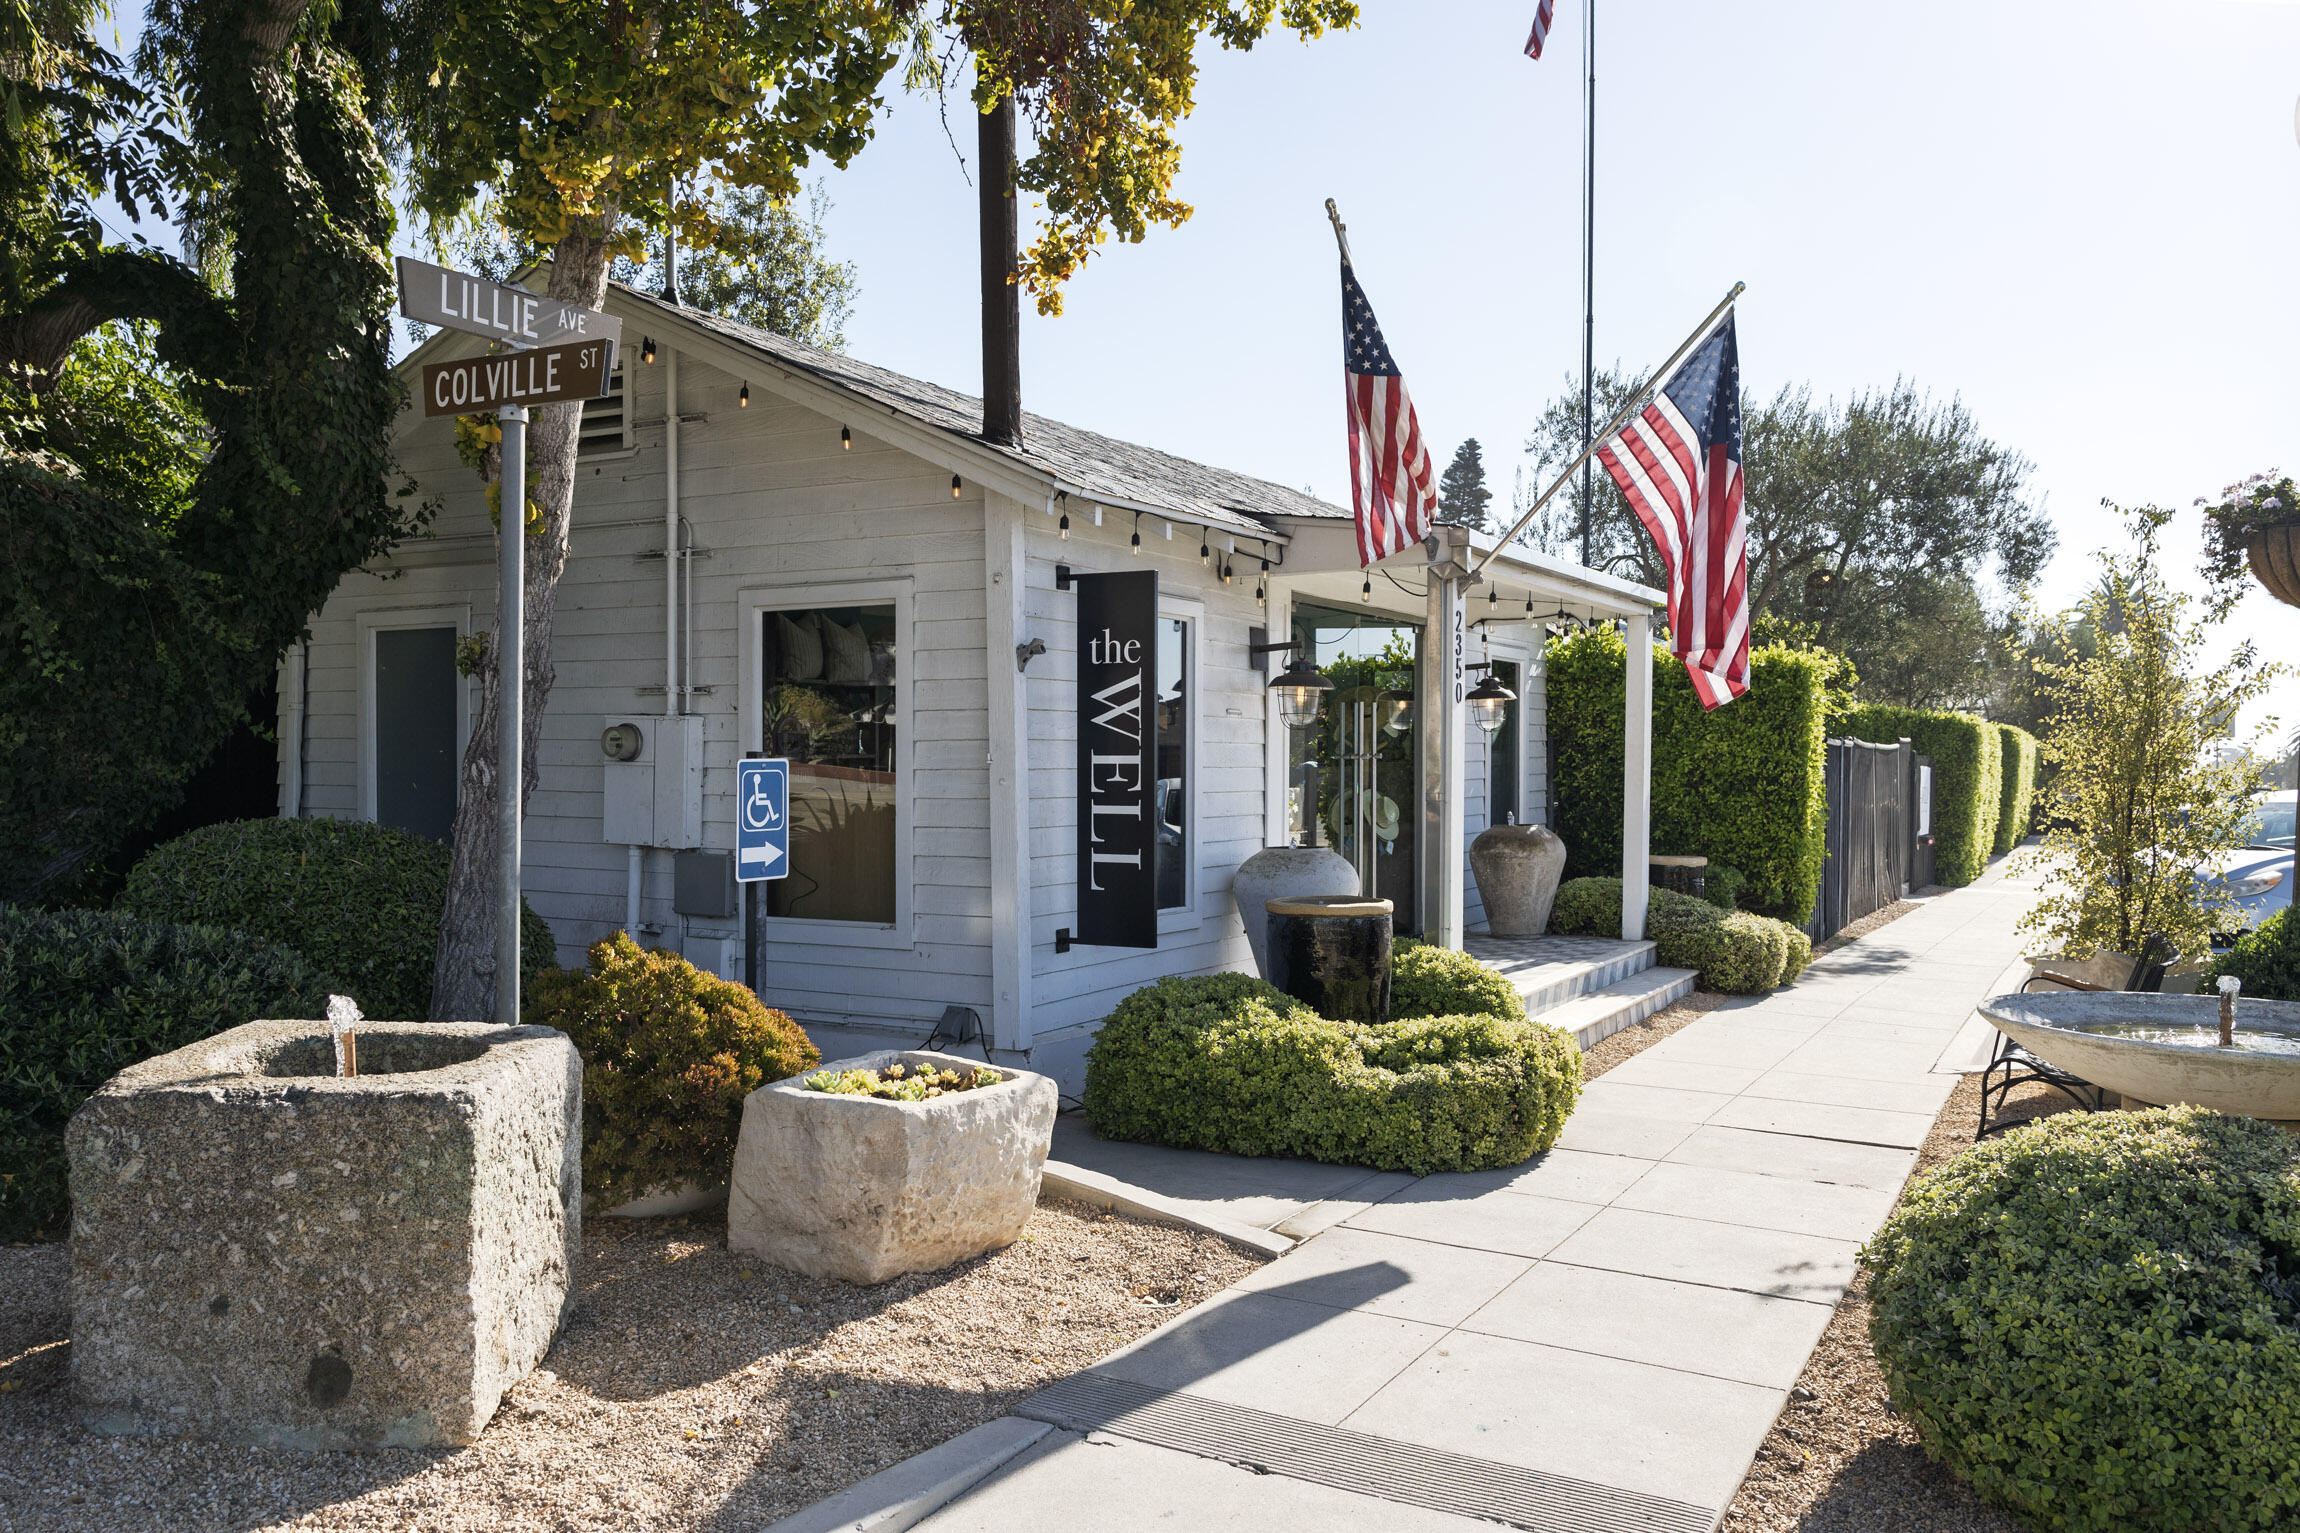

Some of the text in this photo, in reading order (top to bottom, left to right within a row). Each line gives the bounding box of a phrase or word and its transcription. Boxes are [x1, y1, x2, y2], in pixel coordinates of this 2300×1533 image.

[441, 273, 587, 338] LILLIE AVE
[435, 348, 598, 408] COLVILLE ST
[1089, 628, 1142, 664] the
[1454, 610, 1462, 704] 2350
[1090, 667, 1142, 891] WELL
